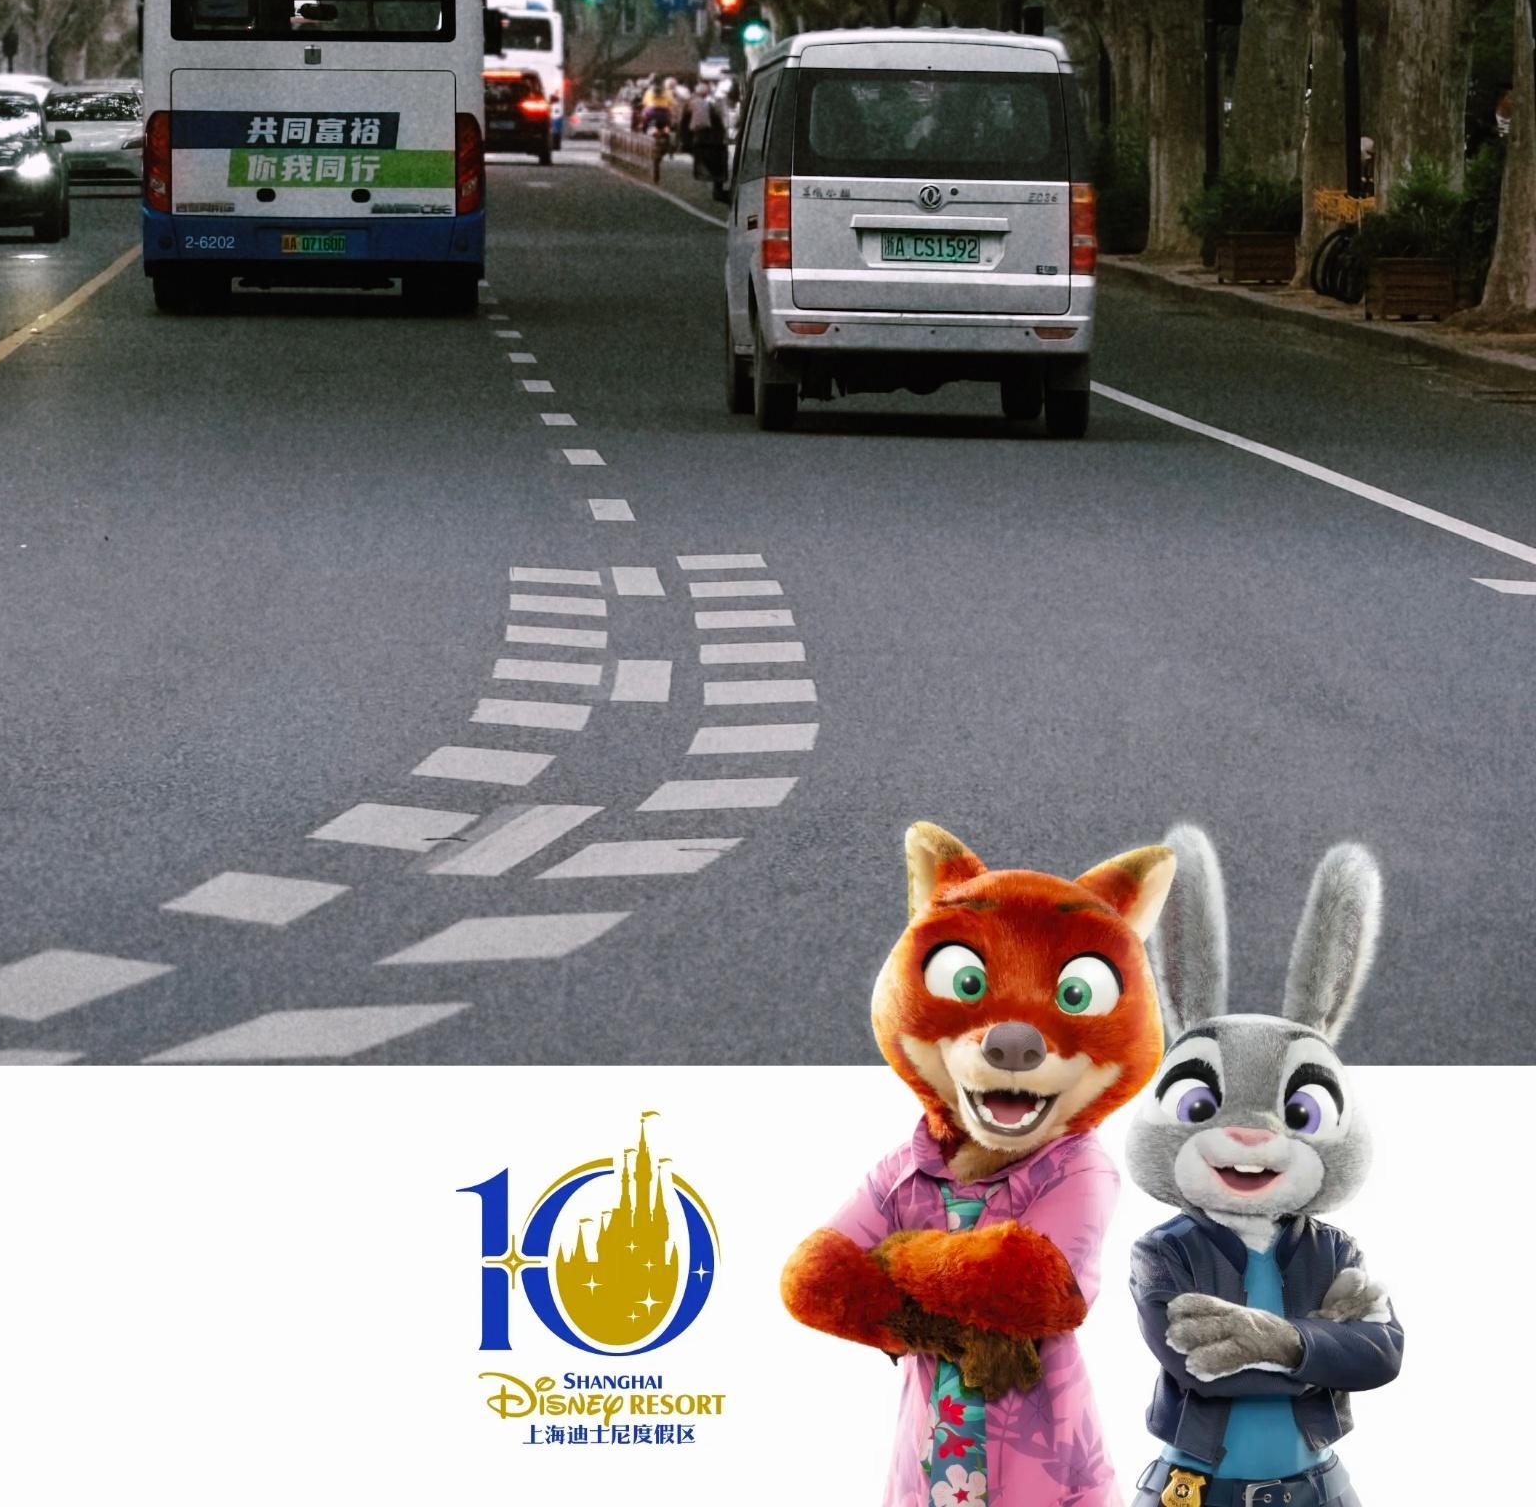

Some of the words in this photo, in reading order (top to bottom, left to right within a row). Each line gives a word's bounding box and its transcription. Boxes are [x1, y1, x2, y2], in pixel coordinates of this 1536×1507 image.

[246, 117, 381, 144] 共同富裕
[247, 154, 381, 182] 你我同行
[185, 236, 235, 250] 2-6202
